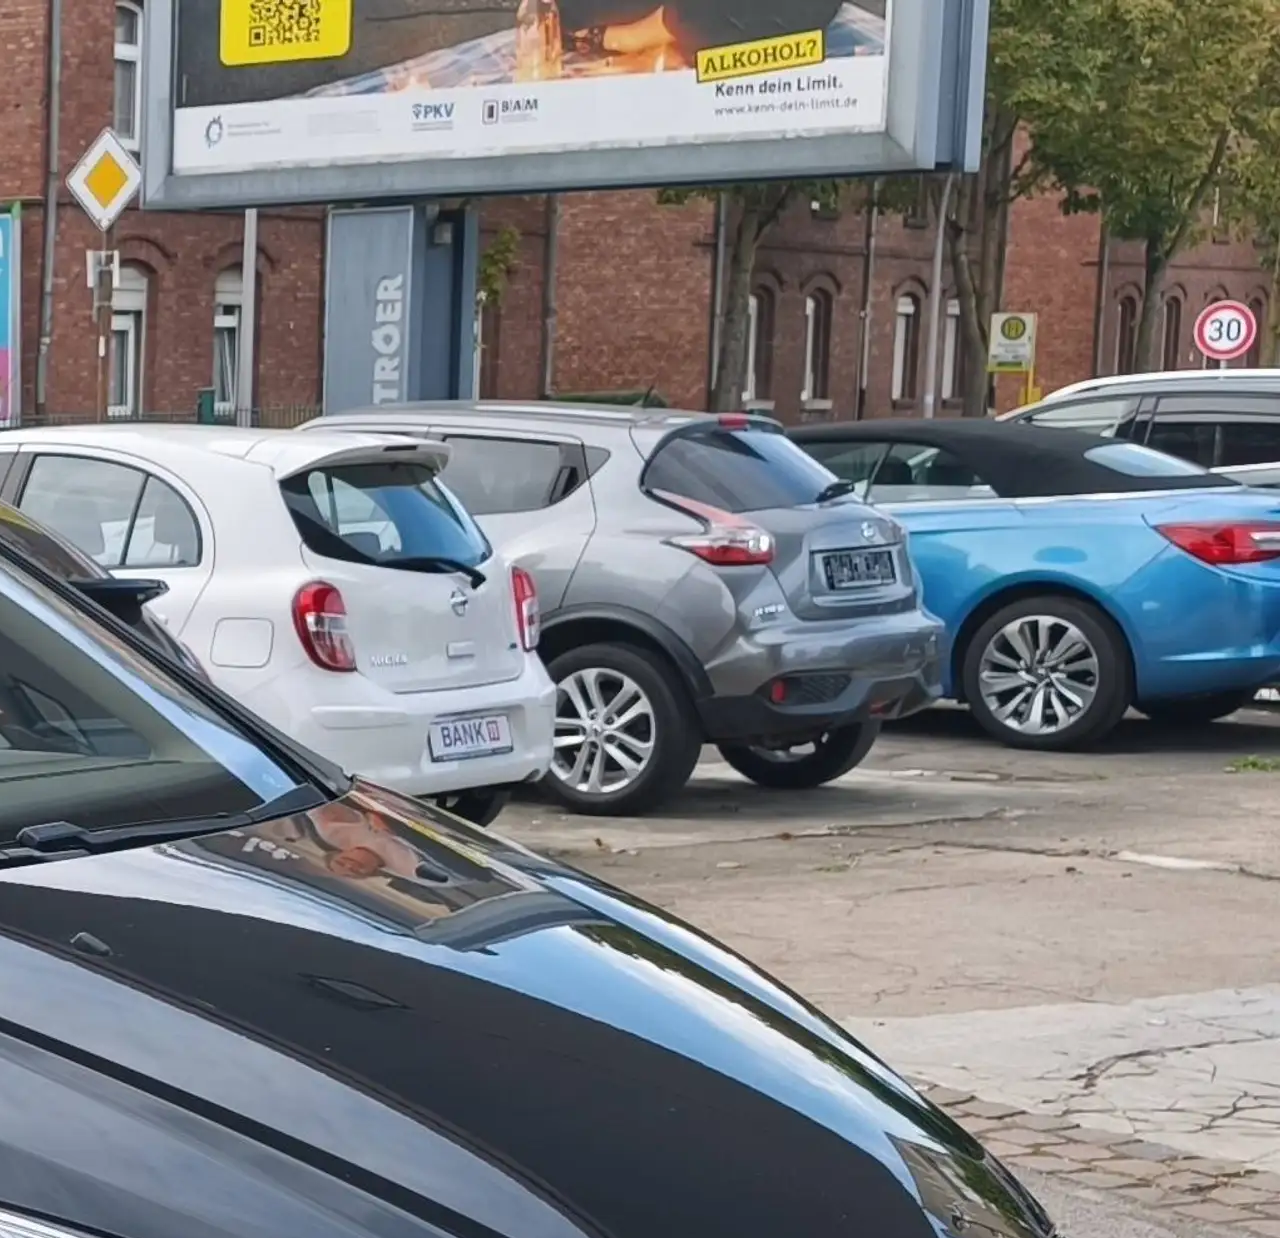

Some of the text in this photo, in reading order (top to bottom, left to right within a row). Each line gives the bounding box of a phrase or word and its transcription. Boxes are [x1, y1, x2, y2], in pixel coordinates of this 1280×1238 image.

[703, 38, 817, 75] ALKOHOL?
[715, 74, 843, 97] Kenn dein Limit.
[423, 102, 454, 119] PKV
[714, 96, 858, 116] www.kenn-dein-limit.de
[1208, 318, 1242, 342] 30
[441, 721, 487, 748] BANK
